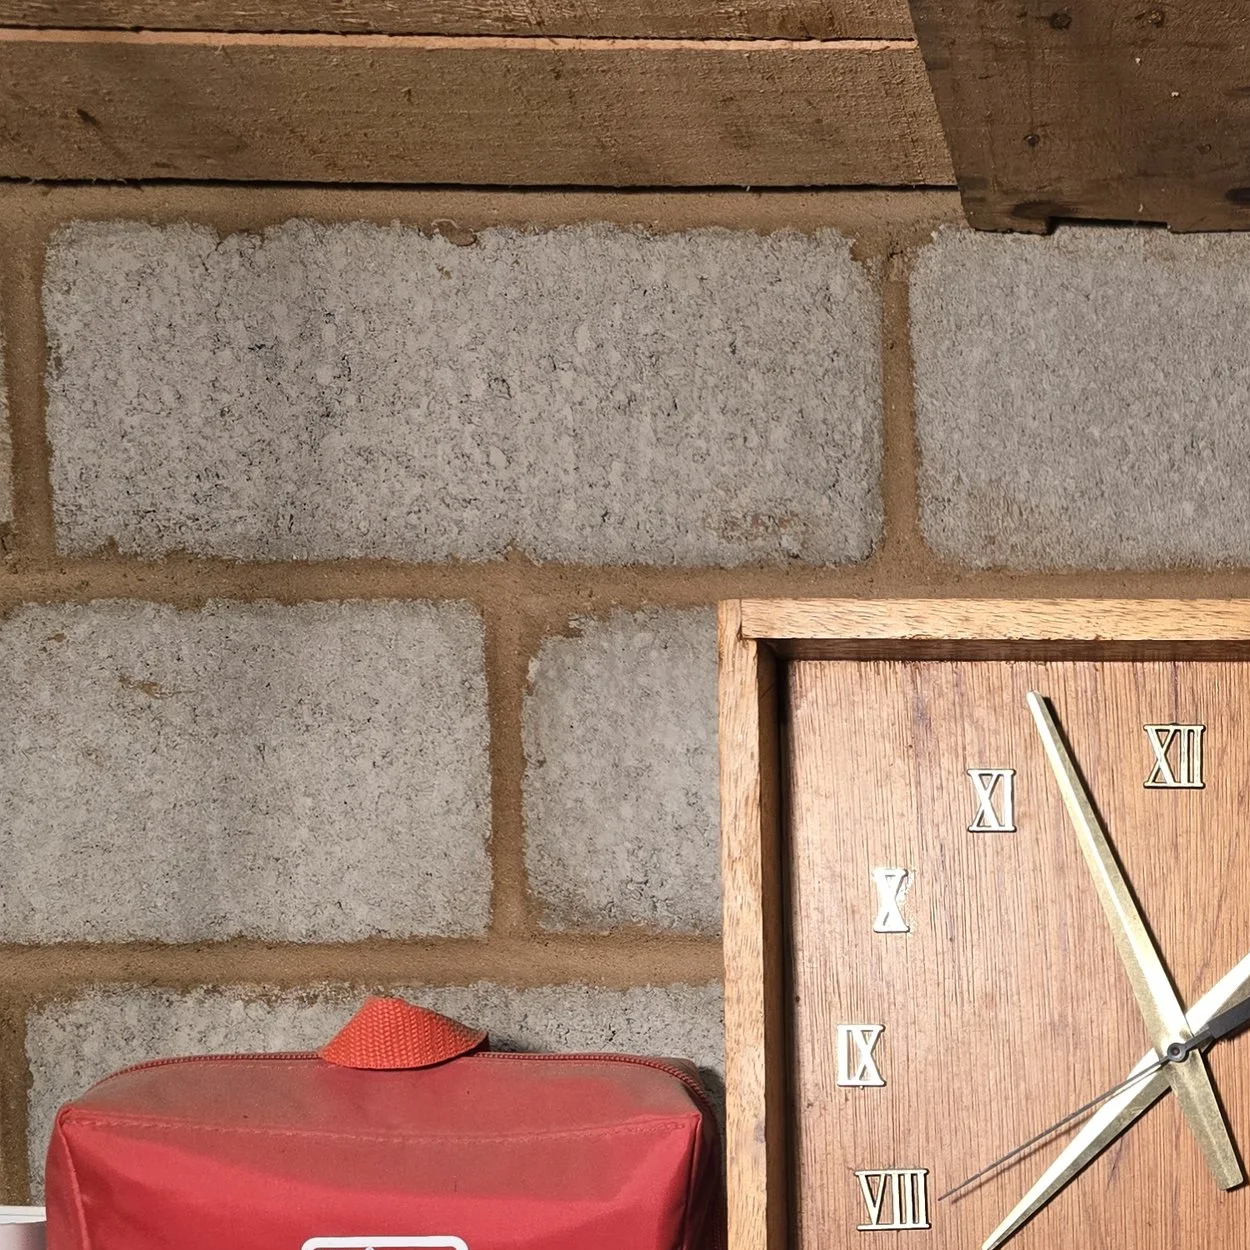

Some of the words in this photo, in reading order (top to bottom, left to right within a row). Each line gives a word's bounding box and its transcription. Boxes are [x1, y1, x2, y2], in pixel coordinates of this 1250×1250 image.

[1143, 722, 1206, 789] XII
[966, 767, 1017, 834] XI
[872, 867, 910, 933] X
[836, 1023, 886, 1089] IX
[854, 1168, 933, 1233] VIII
